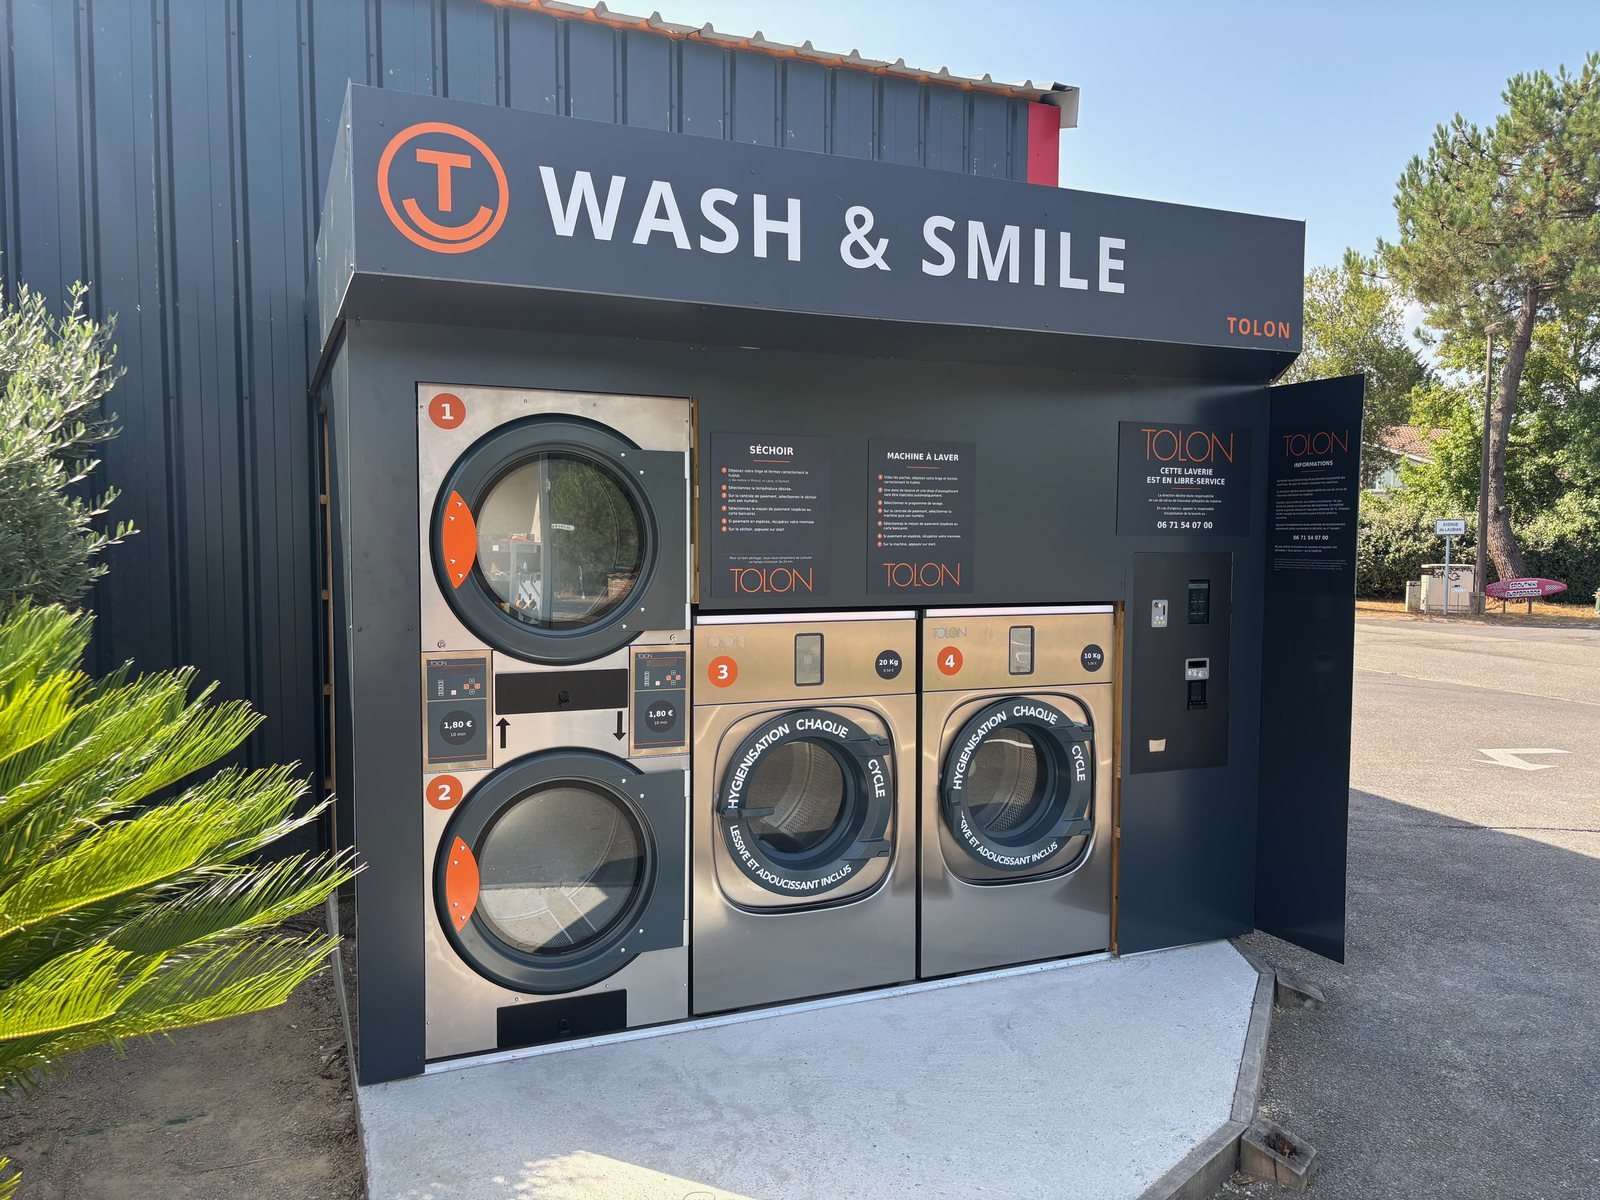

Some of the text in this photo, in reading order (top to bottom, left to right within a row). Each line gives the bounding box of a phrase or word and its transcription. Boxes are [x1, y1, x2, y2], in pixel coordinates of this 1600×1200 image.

[539, 166, 1126, 294] WASH & SMILE
[1227, 317, 1291, 339] TOLON
[441, 403, 454, 420] 1
[749, 443, 794, 456] SÉCHOIR
[1140, 429, 1234, 464] TOLON
[1283, 430, 1349, 457] TOLON
[887, 451, 959, 462] MACHINE À LAVER
[1293, 460, 1333, 468] INFORMATIONS
[1160, 467, 1213, 476] CETTE LAVERIE
[1147, 476, 1161, 484] EST
[1173, 477, 1226, 486] LIBRE-SERVICE
[1157, 521, 1213, 529] 06 71 54 07 00
[729, 568, 813, 593] TOLON
[883, 562, 961, 588] TOLON
[889, 658, 899, 667] Kg
[944, 654, 955, 668] 4
[1092, 652, 1101, 660] Kg
[717, 664, 728, 680] 3
[648, 710, 666, 718] 1,80
[443, 720, 473, 729] 1,80 €
[953, 705, 1086, 790] HYGIENISATION CHAQUE CYCLE
[728, 718, 886, 809] HYGIENISATION CHAQUE CYCLE
[438, 785, 451, 801] 2
[729, 825, 852, 890] LESSIVE ET ADOUCISSANT INCLUS
[968, 836, 980, 848] ET
[976, 845, 1031, 866] ADOUCISSANT
[1031, 841, 1058, 862] INCLUS
